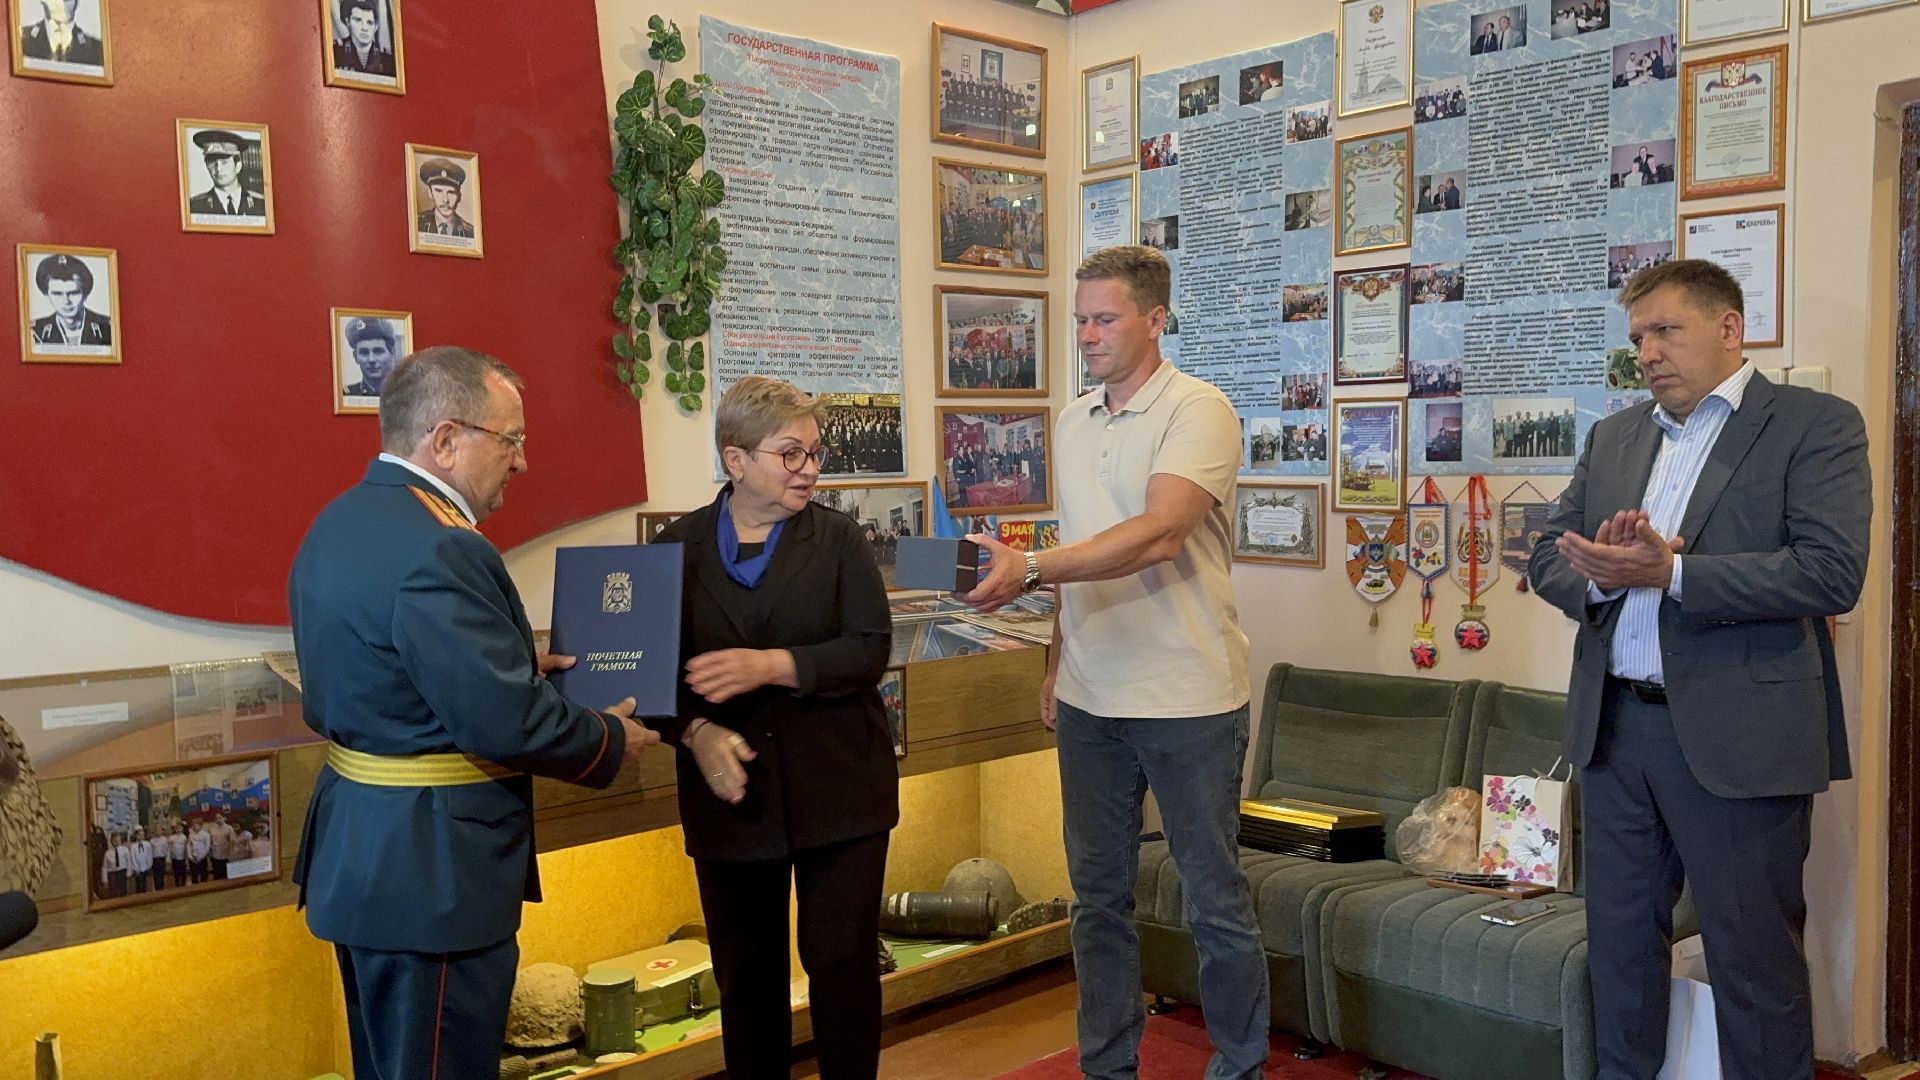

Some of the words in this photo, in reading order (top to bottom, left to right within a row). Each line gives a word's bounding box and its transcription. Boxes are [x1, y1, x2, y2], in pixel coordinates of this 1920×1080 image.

[727, 32, 820, 60] ГОСУДАРСТВЕННАЯ
[823, 52, 878, 72] ПРОГРАММА
[1700, 87, 1767, 104] БЛАГОДАРСТВЕННОЕ
[723, 91, 779, 108] вершенствование
[870, 118, 894, 126] системы
[1719, 101, 1747, 110] ПИСЬМО
[801, 114, 824, 124] граждан
[827, 118, 859, 129] Российской
[771, 137, 797, 147] граждан
[864, 141, 893, 152] Отечества
[709, 146, 744, 157] упрочение
[860, 167, 893, 178] Российской
[725, 185, 767, 197] печивающего
[722, 192, 760, 204] ффективное
[765, 216, 799, 226] Российской
[726, 221, 769, 233] мобилизация
[720, 268, 757, 277] сударствен-
[719, 295, 739, 303] оссии,
[723, 348, 757, 356] Основным
[718, 358, 754, 366] Программы
[1002, 523, 1010, 538] 9
[1011, 523, 1035, 536] МАЯ
[586, 651, 643, 662] ПОЧЕТНАЯ
[590, 662, 637, 671] ГРАМОТА
